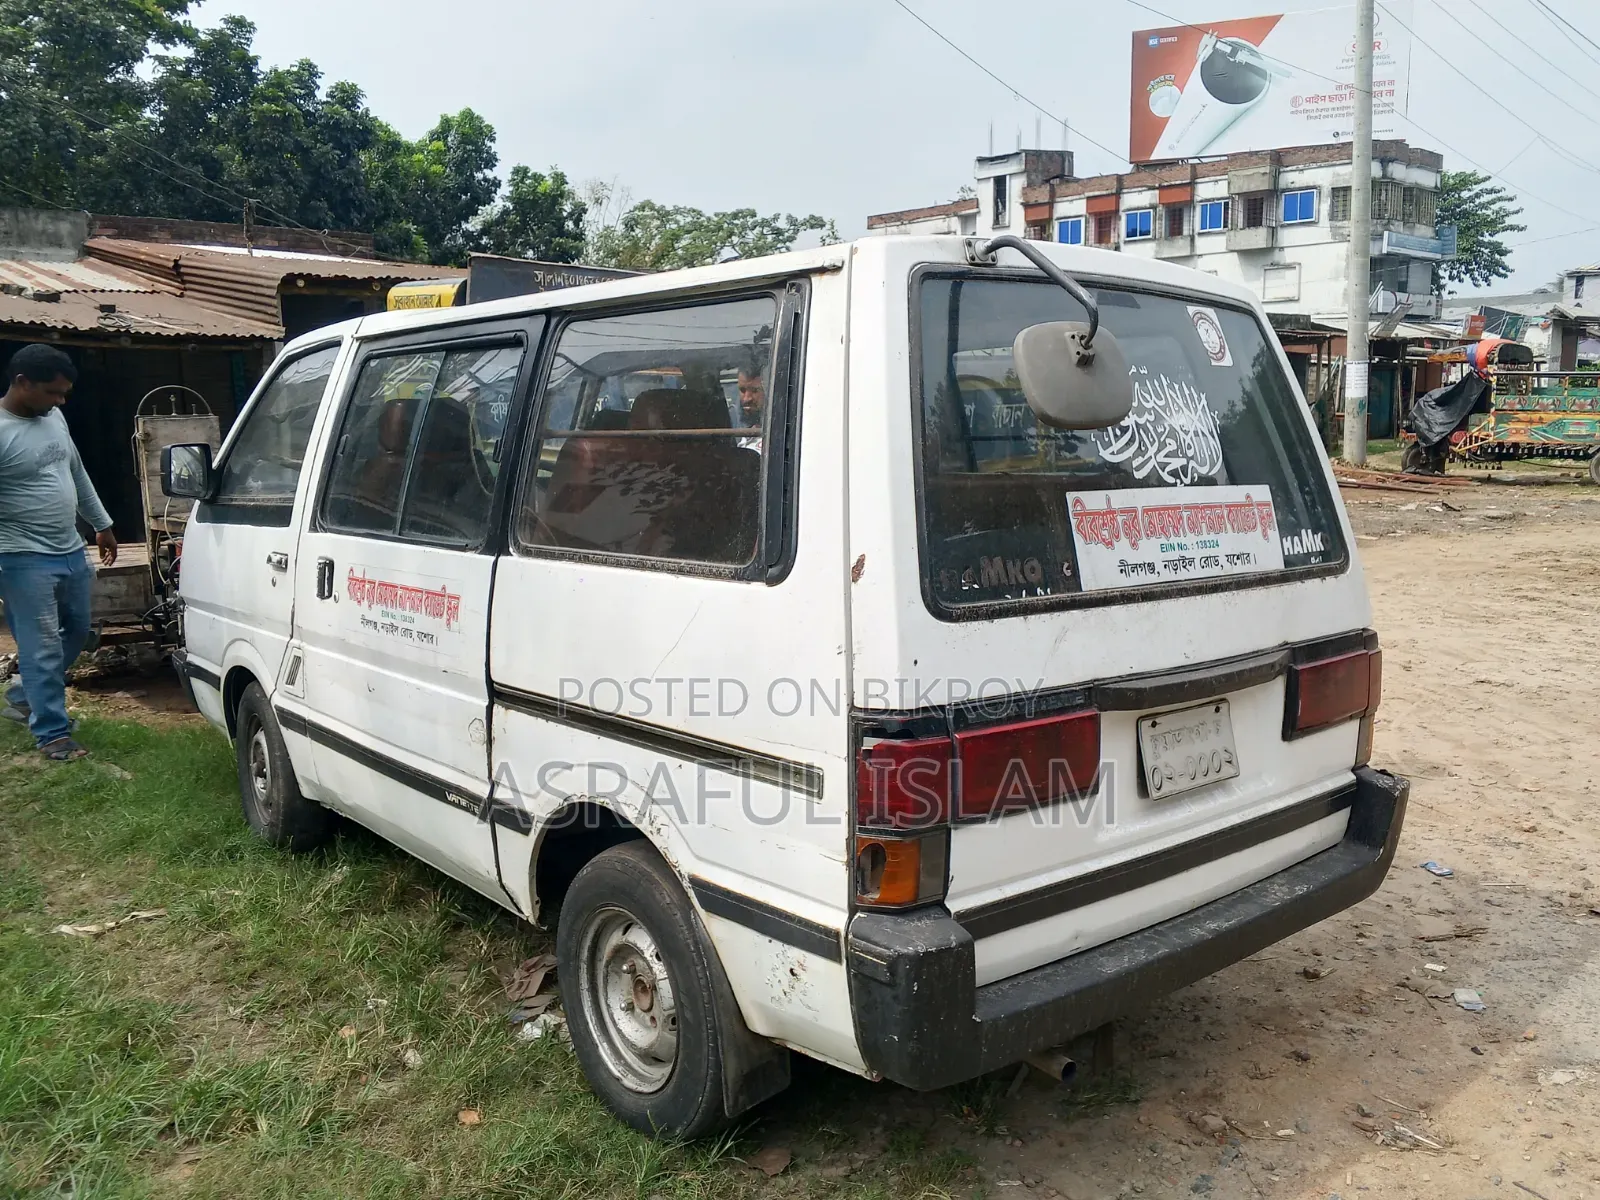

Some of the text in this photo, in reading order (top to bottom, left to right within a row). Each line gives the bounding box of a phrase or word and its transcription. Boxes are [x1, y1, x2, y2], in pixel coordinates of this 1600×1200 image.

[1118, 507, 1142, 550] নূর
[1182, 502, 1228, 537] ন্যাশনাল
[1223, 493, 1258, 534] ক্যাডেট
[1255, 501, 1276, 543] স্কুল
[1196, 539, 1220, 550] 138324
[1117, 559, 1161, 579] নীলগঞ্জ,
[1162, 554, 1196, 576] নড়াইল
[1199, 554, 1224, 571] রোড,
